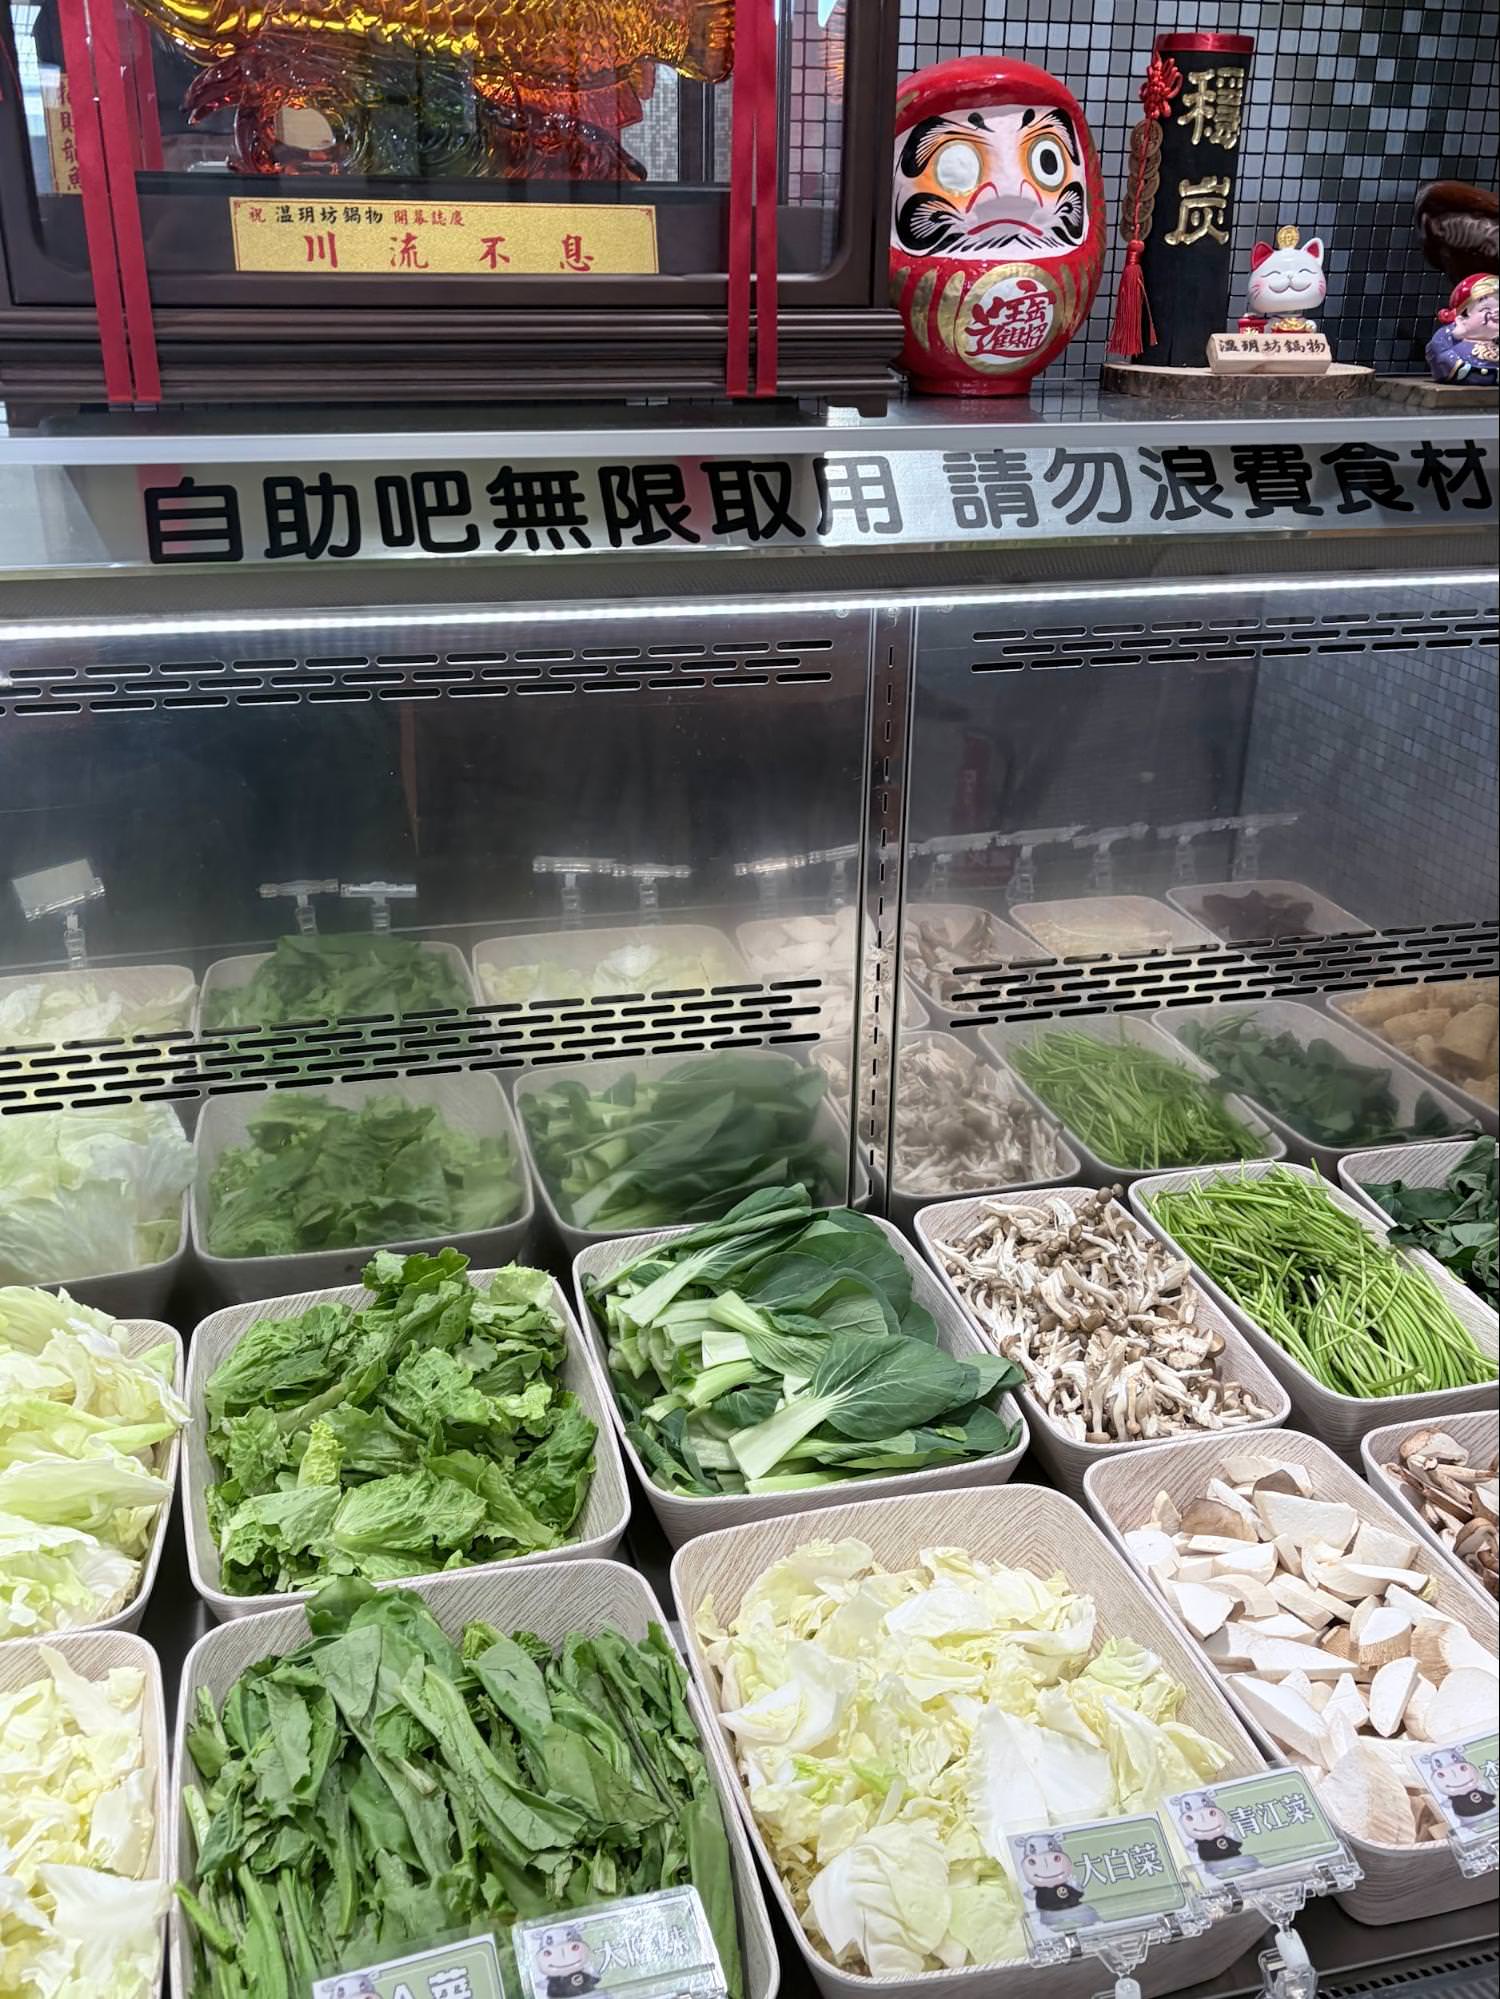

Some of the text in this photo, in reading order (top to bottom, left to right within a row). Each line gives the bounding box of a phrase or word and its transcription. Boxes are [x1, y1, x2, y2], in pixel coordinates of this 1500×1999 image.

[249, 207, 266, 224] 祝
[303, 231, 594, 272] 川流不息
[144, 440, 1494, 564] 自助吧無限取用 請勿浪費食材
[1229, 1792, 1314, 1839] 青江菜
[1074, 1842, 1164, 1888] 大白菜
